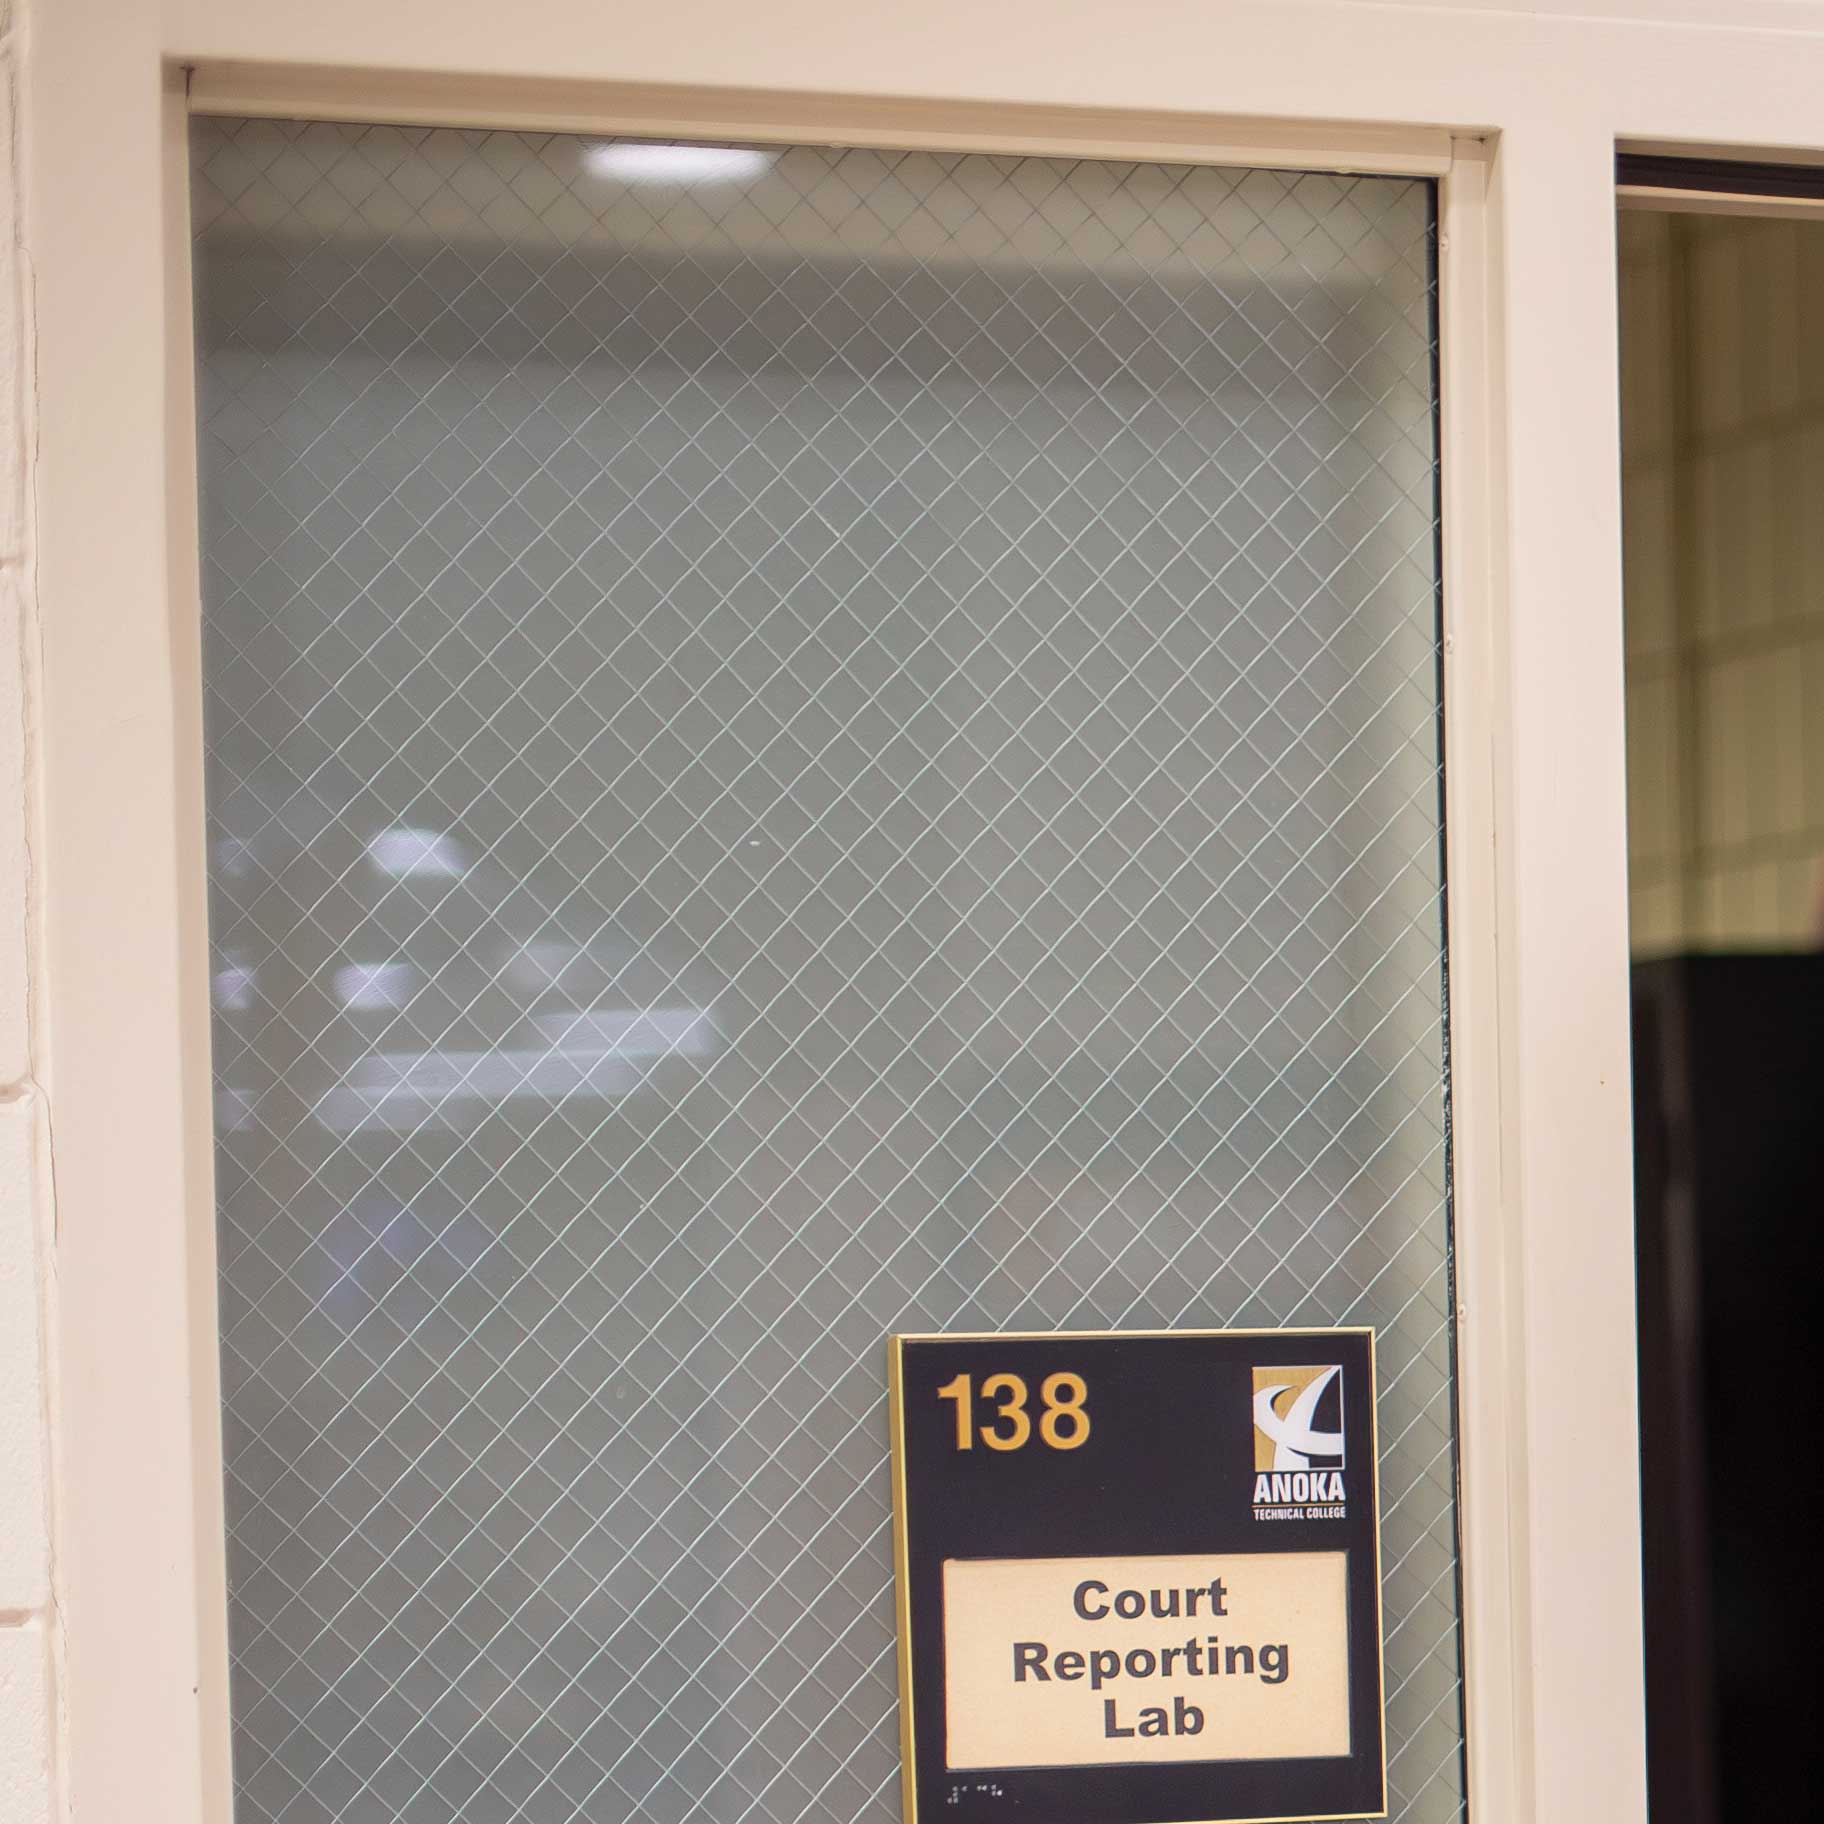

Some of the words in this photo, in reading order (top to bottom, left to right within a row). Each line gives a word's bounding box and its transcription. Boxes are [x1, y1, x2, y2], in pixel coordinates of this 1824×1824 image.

[936, 1371, 1092, 1452] 138
[1253, 1471, 1346, 1503] ANOKA
[1253, 1507, 1304, 1520] TECHNICAL
[1306, 1506, 1346, 1519] COLLEGE
[1072, 1576, 1228, 1621] Court
[1012, 1635, 1290, 1691] Reporting
[1103, 1697, 1205, 1739] Lab
